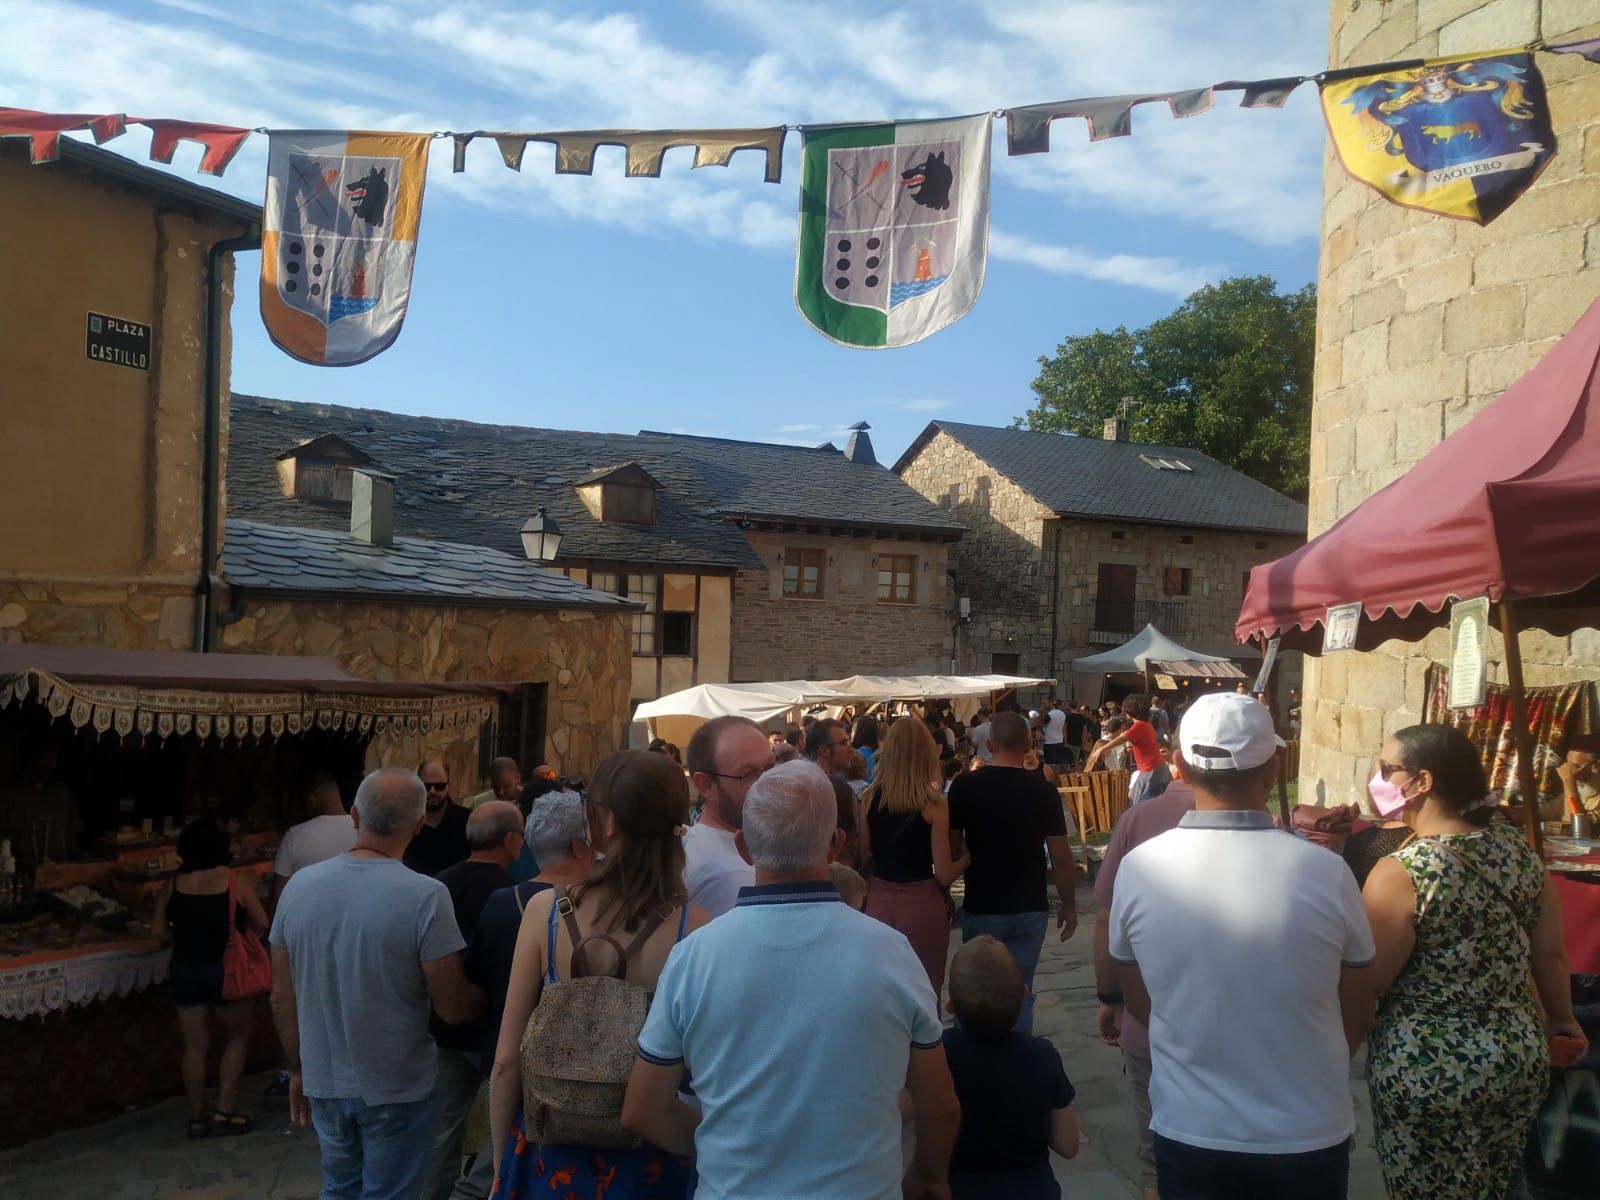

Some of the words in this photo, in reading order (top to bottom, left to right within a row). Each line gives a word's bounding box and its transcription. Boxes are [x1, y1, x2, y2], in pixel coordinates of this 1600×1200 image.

[1433, 160, 1502, 183] VAQUERO
[107, 320, 144, 337] PLAZA
[91, 343, 146, 368] CASTILLO
